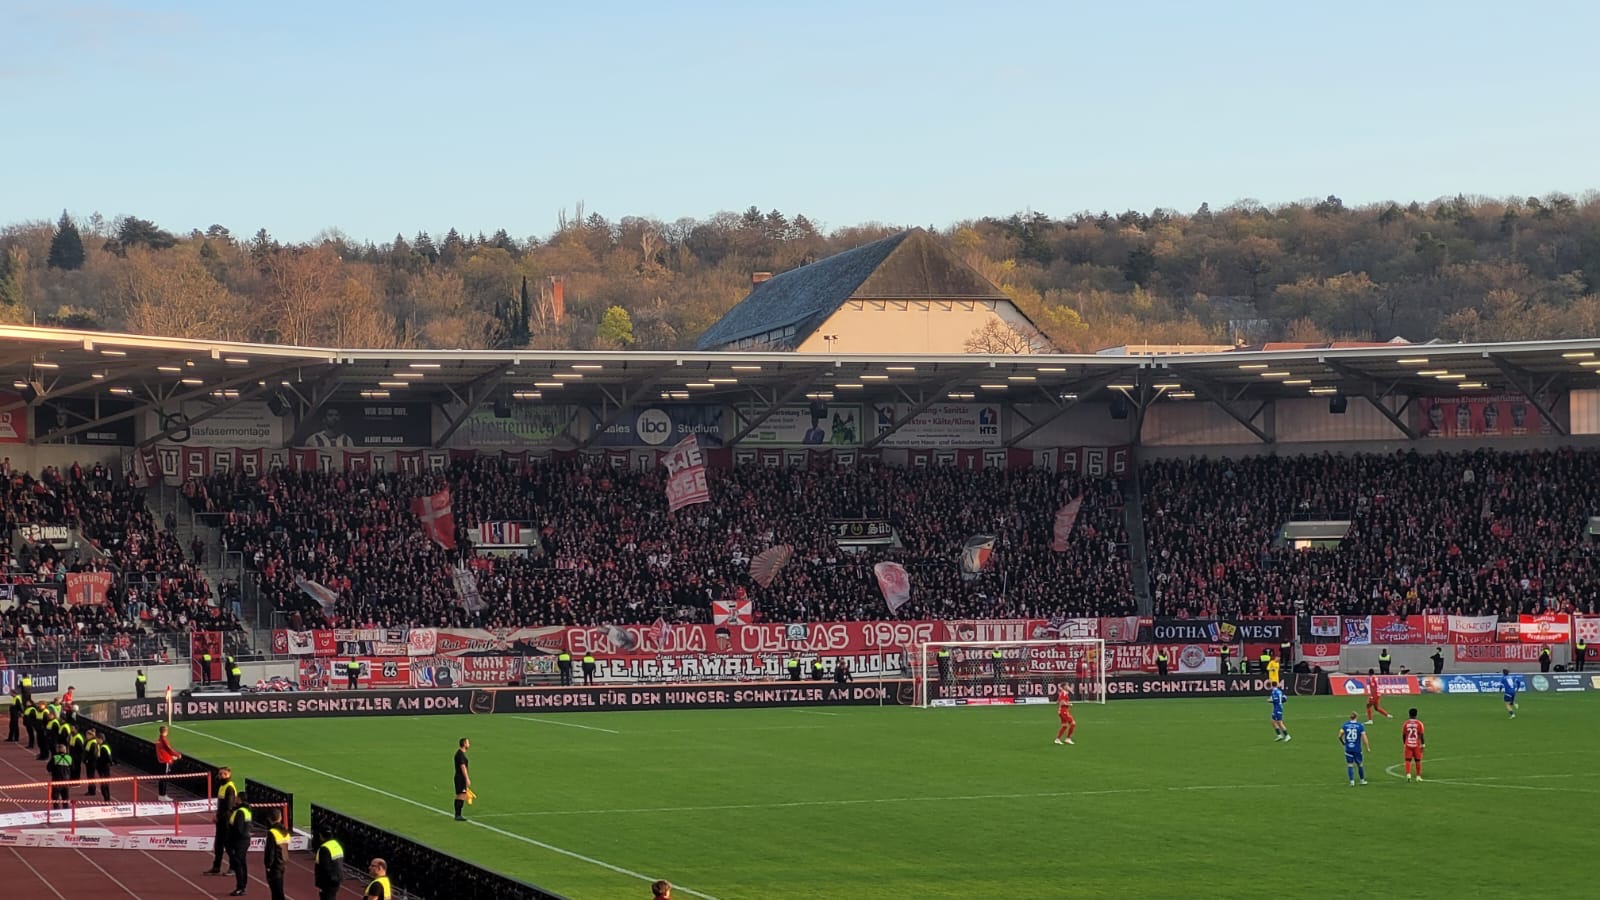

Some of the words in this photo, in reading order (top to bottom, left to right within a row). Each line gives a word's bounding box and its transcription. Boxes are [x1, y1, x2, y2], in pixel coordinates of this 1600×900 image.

[641, 418, 667, 433] iba
[677, 423, 719, 433] Studium
[980, 426, 998, 434] HTS
[1042, 450, 1128, 476] 1966
[1154, 625, 1207, 639] GOTHA
[1239, 625, 1282, 639] WEST
[568, 625, 706, 655] ERORDIA
[1031, 647, 1066, 659] Gotha
[1142, 645, 1179, 666] KAT
[1504, 645, 1521, 658] ROT
[384, 666, 397, 677] 66
[571, 653, 902, 678] STEIGERWALDTADION
[1031, 659, 1078, 671] Rot-Wei
[939, 684, 1014, 698] HEIMSPIEL
[1017, 681, 1044, 695] FÜR
[1047, 683, 1074, 695] DN
[1142, 679, 1227, 693] SCHNITZLER
[1230, 679, 1251, 691] AM
[515, 694, 596, 706] HEIMSPIEL
[599, 690, 627, 705] FÜR
[631, 692, 661, 705] DEN
[665, 690, 729, 704] HUNGER:
[733, 688, 824, 703] SCHNITZLER
[830, 688, 850, 700] AM
[853, 687, 891, 700] DOM.
[187, 701, 219, 715] DEN
[223, 699, 292, 714] HUNGER:
[296, 697, 392, 712] SCHNITZLER
[396, 697, 420, 709] AM
[424, 695, 464, 710] DOM.
[1346, 729, 1357, 740] 26
[1407, 728, 1418, 740] 23
[63, 835, 101, 843] NextPhones
[149, 837, 188, 845] NextPhones
